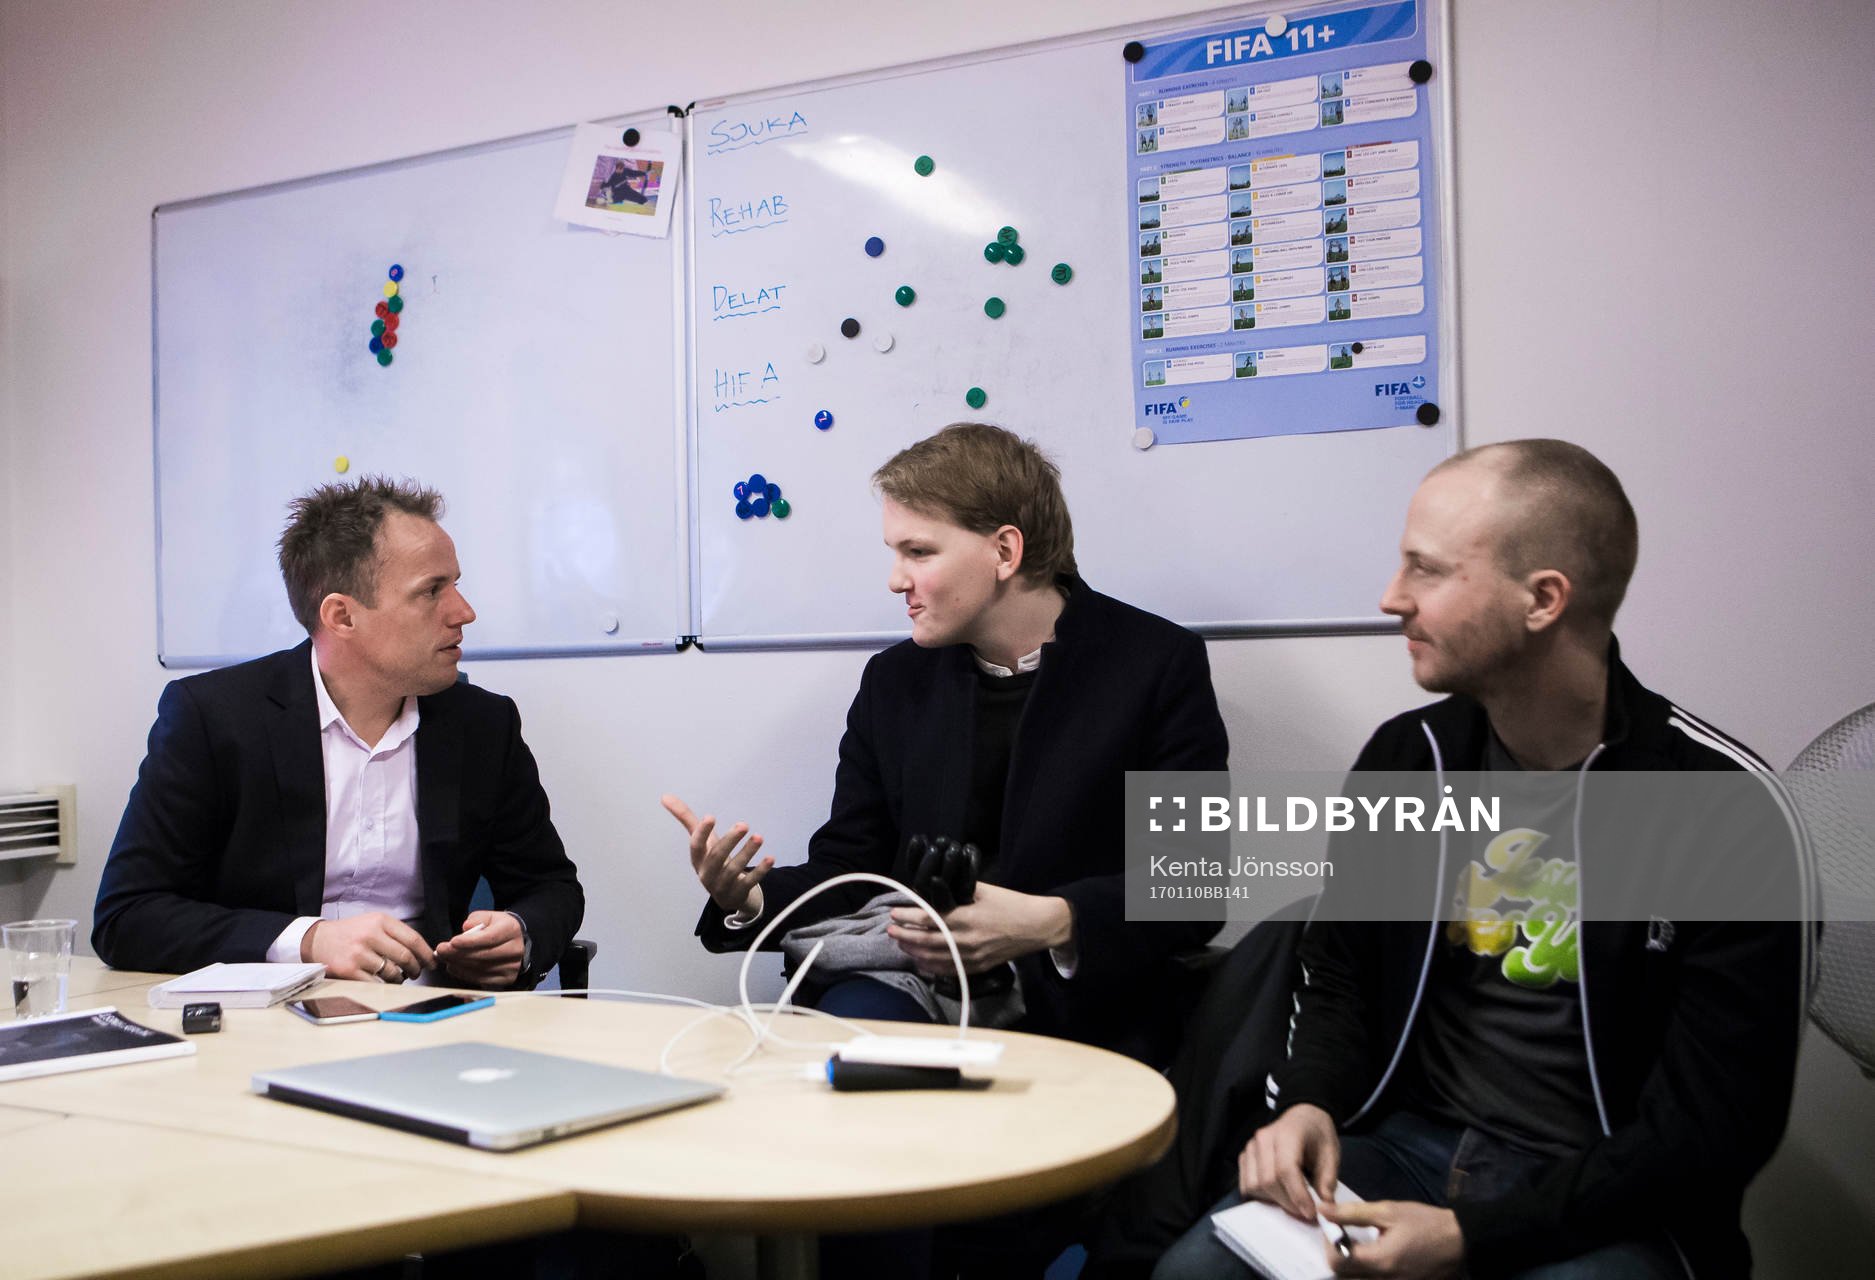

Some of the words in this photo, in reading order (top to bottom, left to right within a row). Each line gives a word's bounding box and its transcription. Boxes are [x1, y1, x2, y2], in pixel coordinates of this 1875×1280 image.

[1206, 33, 1274, 65] FIFA
[1285, 24, 1335, 51] 11+
[708, 112, 807, 147] SJUKA
[709, 195, 788, 227] REHAB
[713, 285, 786, 312] DELAT
[714, 368, 750, 398] HIF
[761, 361, 778, 389] A
[1375, 382, 1411, 397] FIFA
[1144, 402, 1177, 416] FIFA
